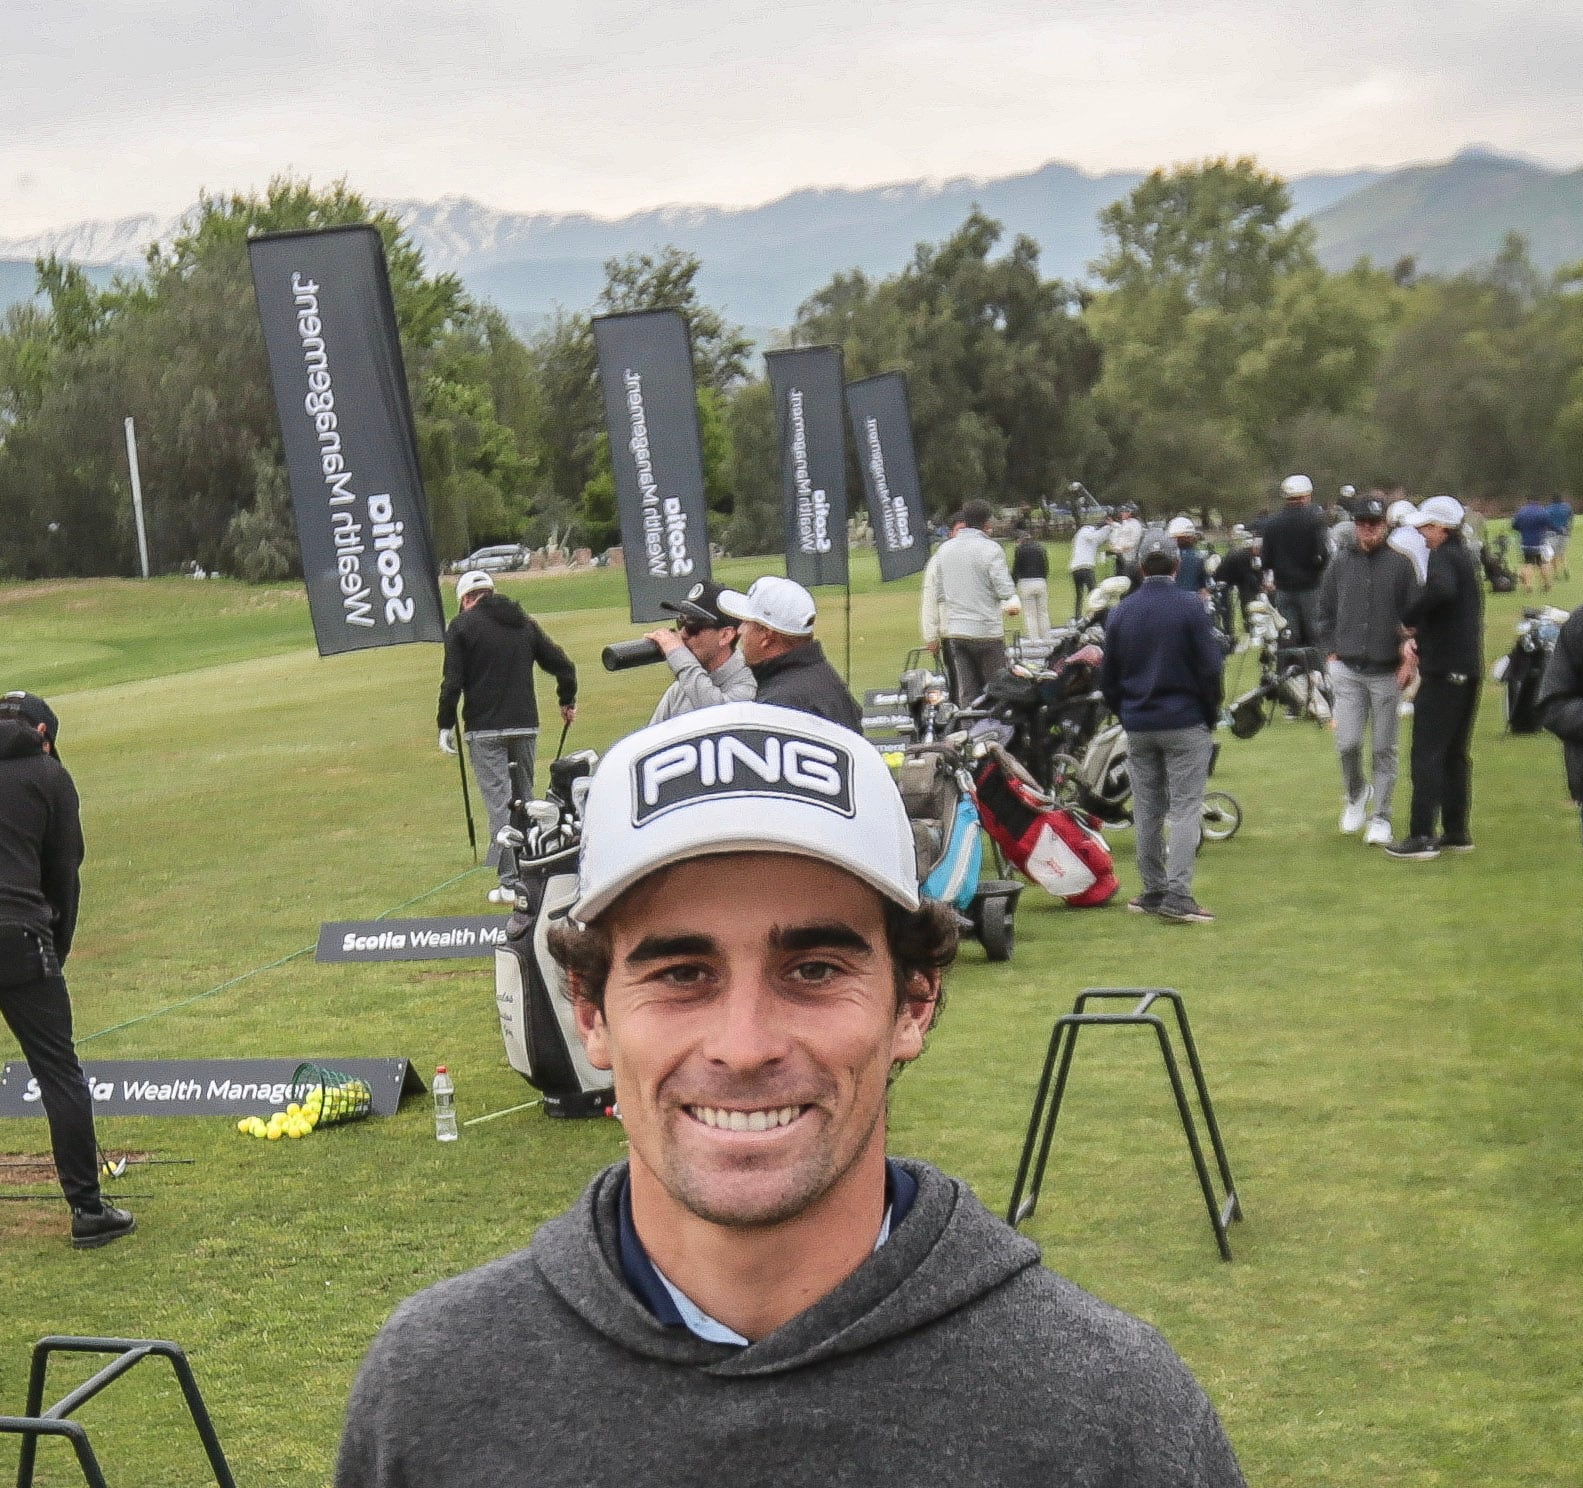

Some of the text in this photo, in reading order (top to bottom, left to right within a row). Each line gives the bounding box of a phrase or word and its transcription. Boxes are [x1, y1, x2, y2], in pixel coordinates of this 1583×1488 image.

[643, 735, 842, 806] PING
[342, 932, 406, 951] Scotia
[410, 928, 476, 948] Wealth
[22, 1077, 115, 1102] Sia
[123, 1079, 201, 1101] Wealth
